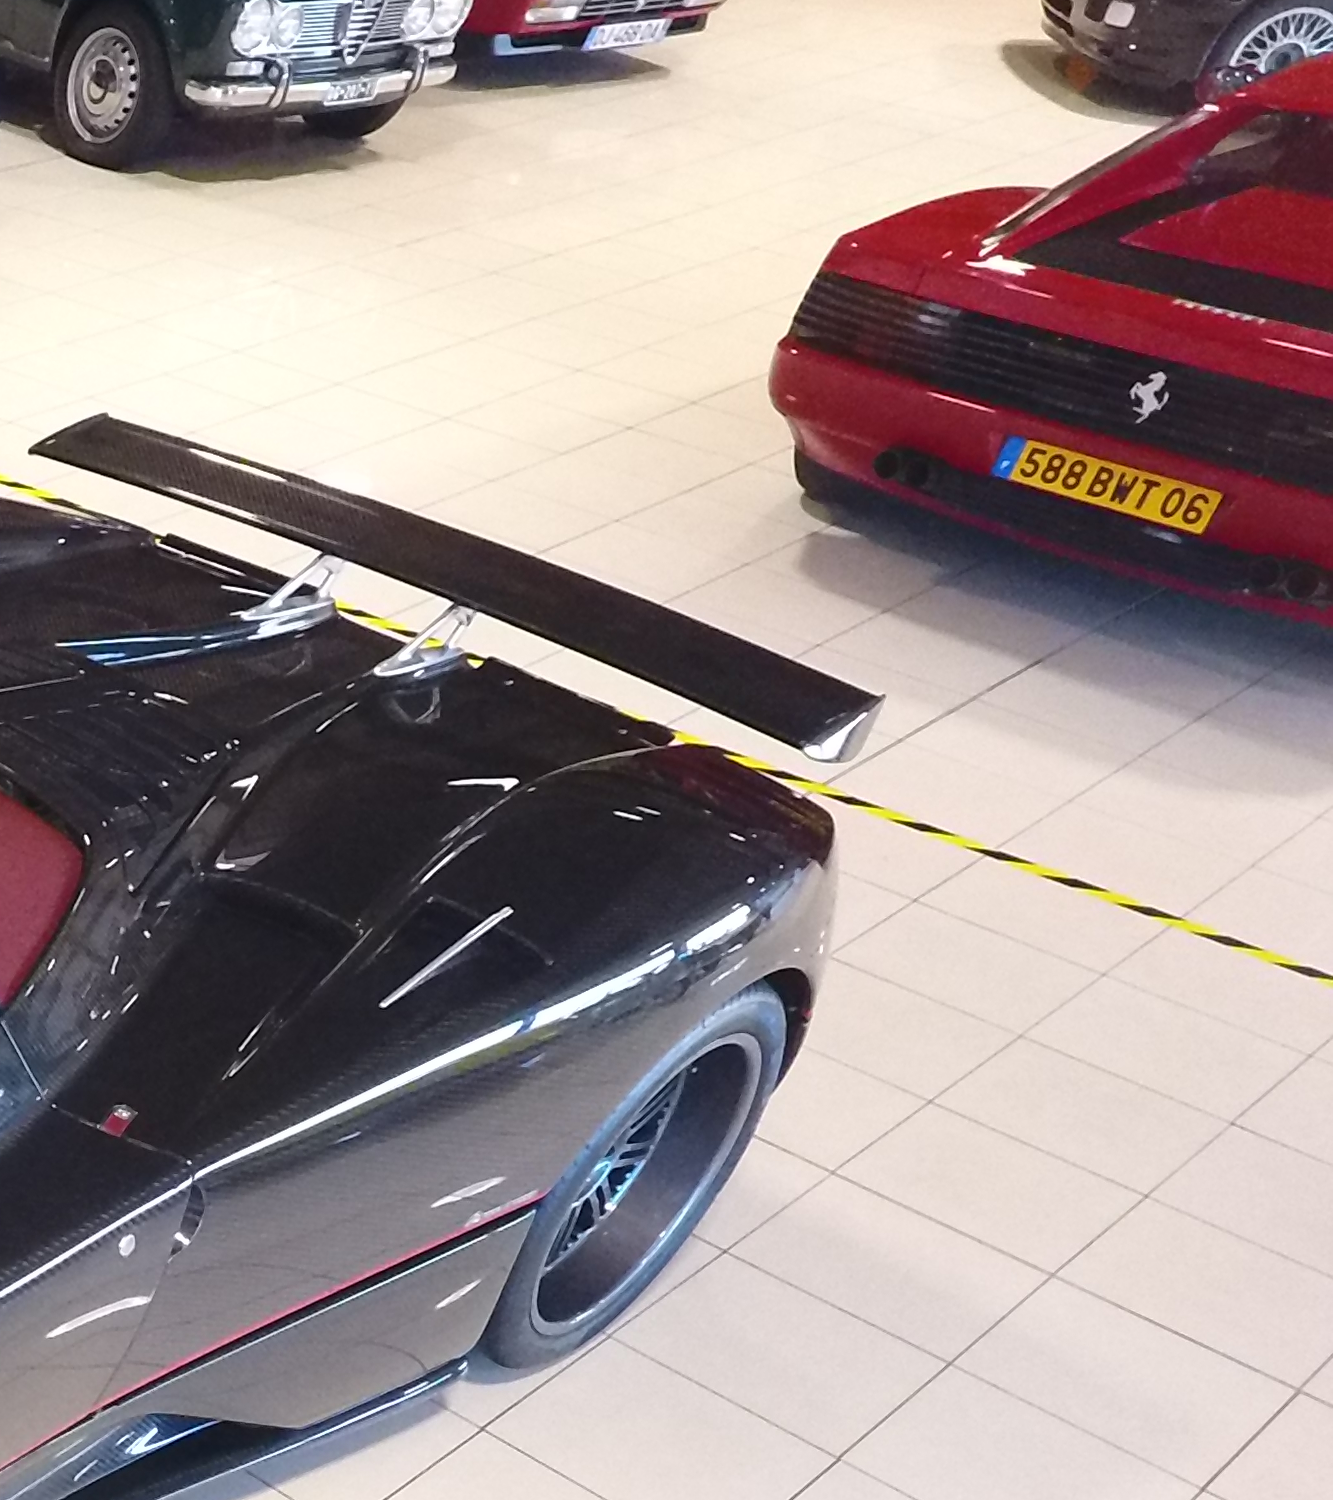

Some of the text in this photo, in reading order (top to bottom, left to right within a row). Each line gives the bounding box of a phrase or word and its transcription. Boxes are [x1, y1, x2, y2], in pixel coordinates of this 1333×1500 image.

[1019, 447, 1210, 526] 588 BWT 06
